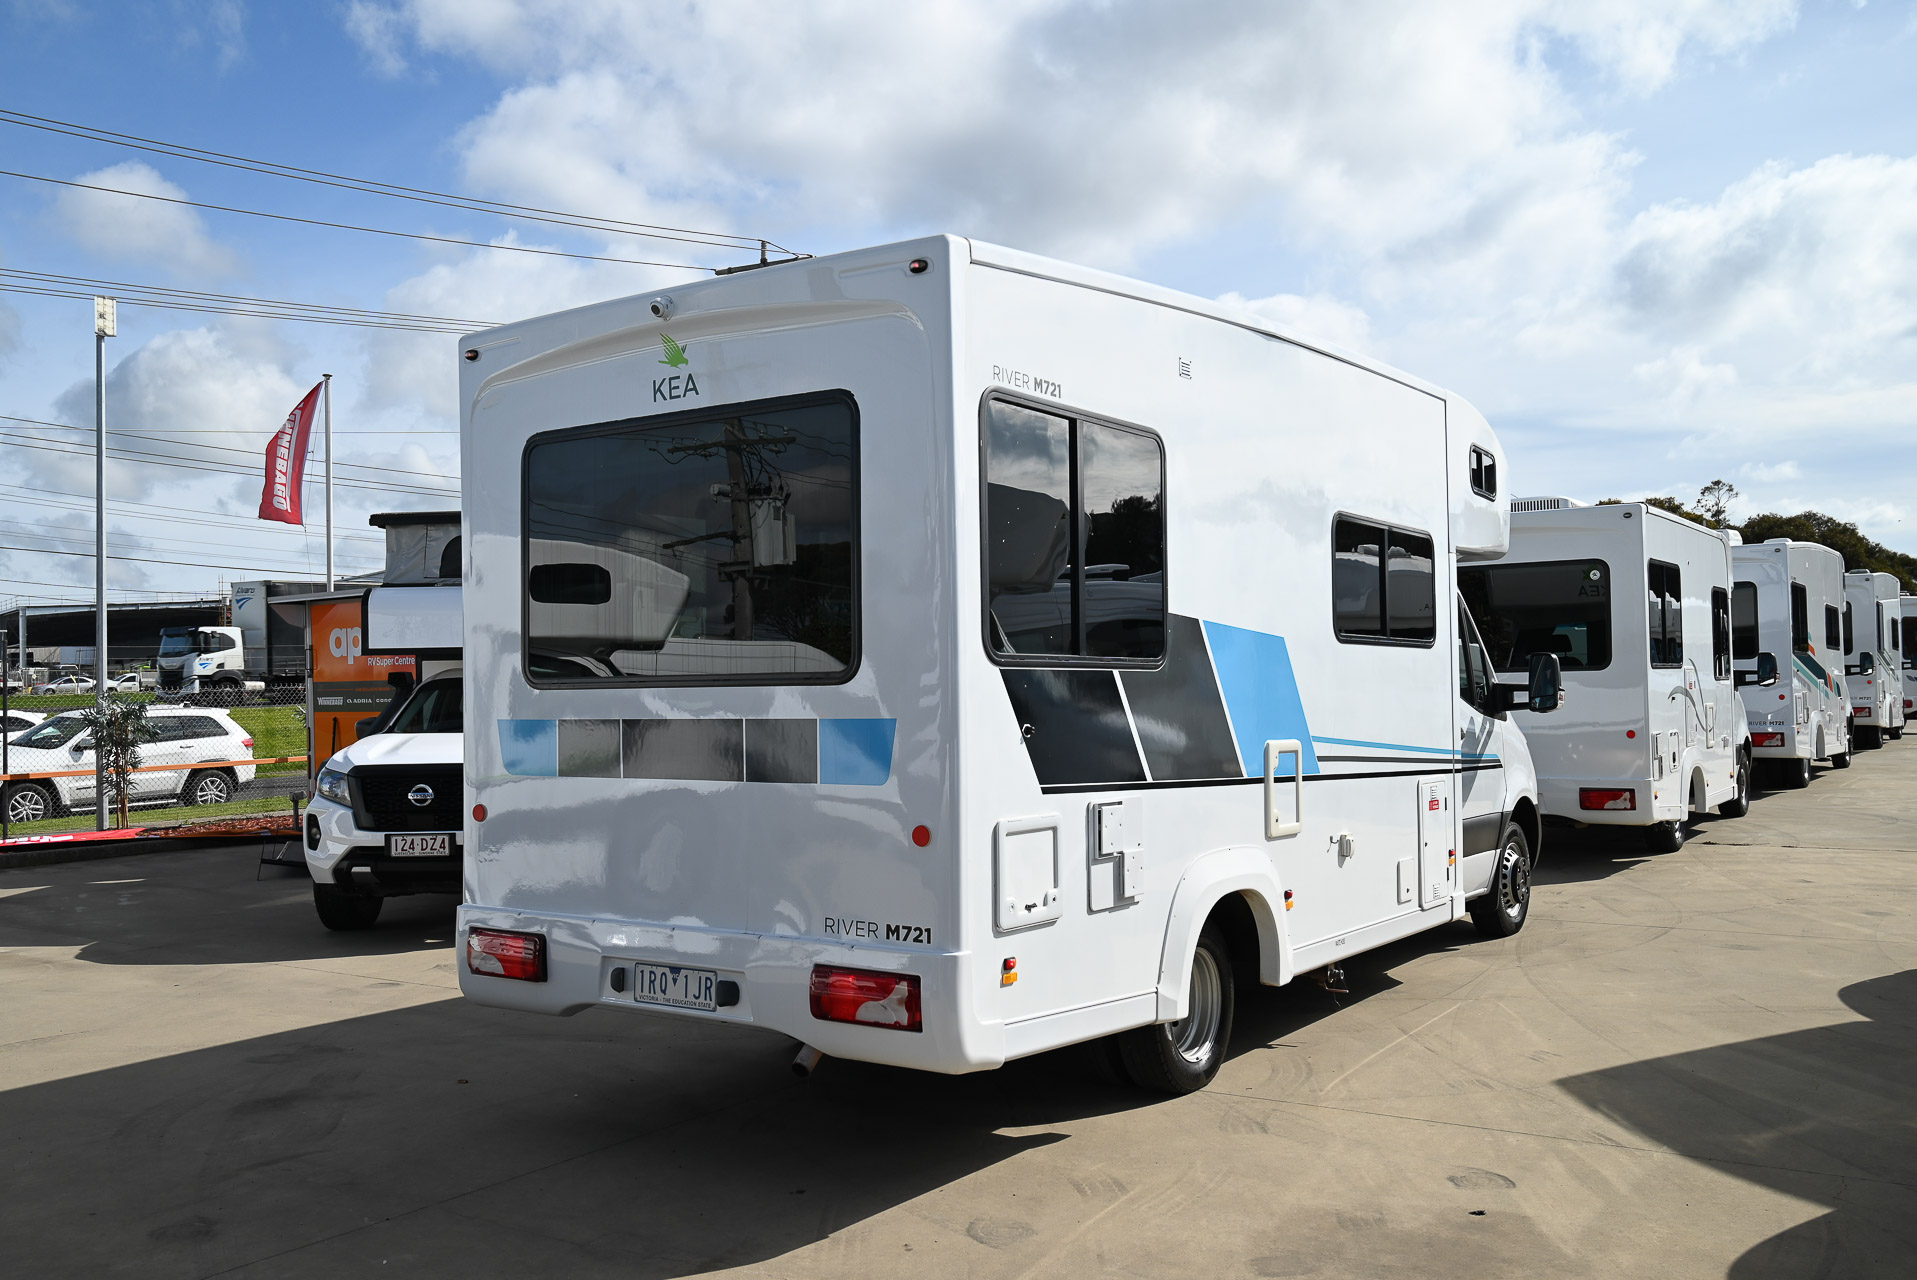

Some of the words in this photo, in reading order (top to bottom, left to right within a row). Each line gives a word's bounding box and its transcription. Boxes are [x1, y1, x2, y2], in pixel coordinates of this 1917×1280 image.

[652, 373, 699, 402] KEA
[993, 365, 1030, 390] RIVER
[1033, 377, 1062, 399] M721
[367, 657, 377, 666] RV
[376, 657, 394, 667] Super
[394, 656, 416, 666] Centre
[824, 917, 879, 939] RIVER
[885, 923, 932, 944] M721
[639, 969, 668, 996] 1RQ
[683, 974, 713, 1002] 1JR
[638, 994, 659, 1002] VICTORIA
[671, 999, 697, 1008] EDUCATION
